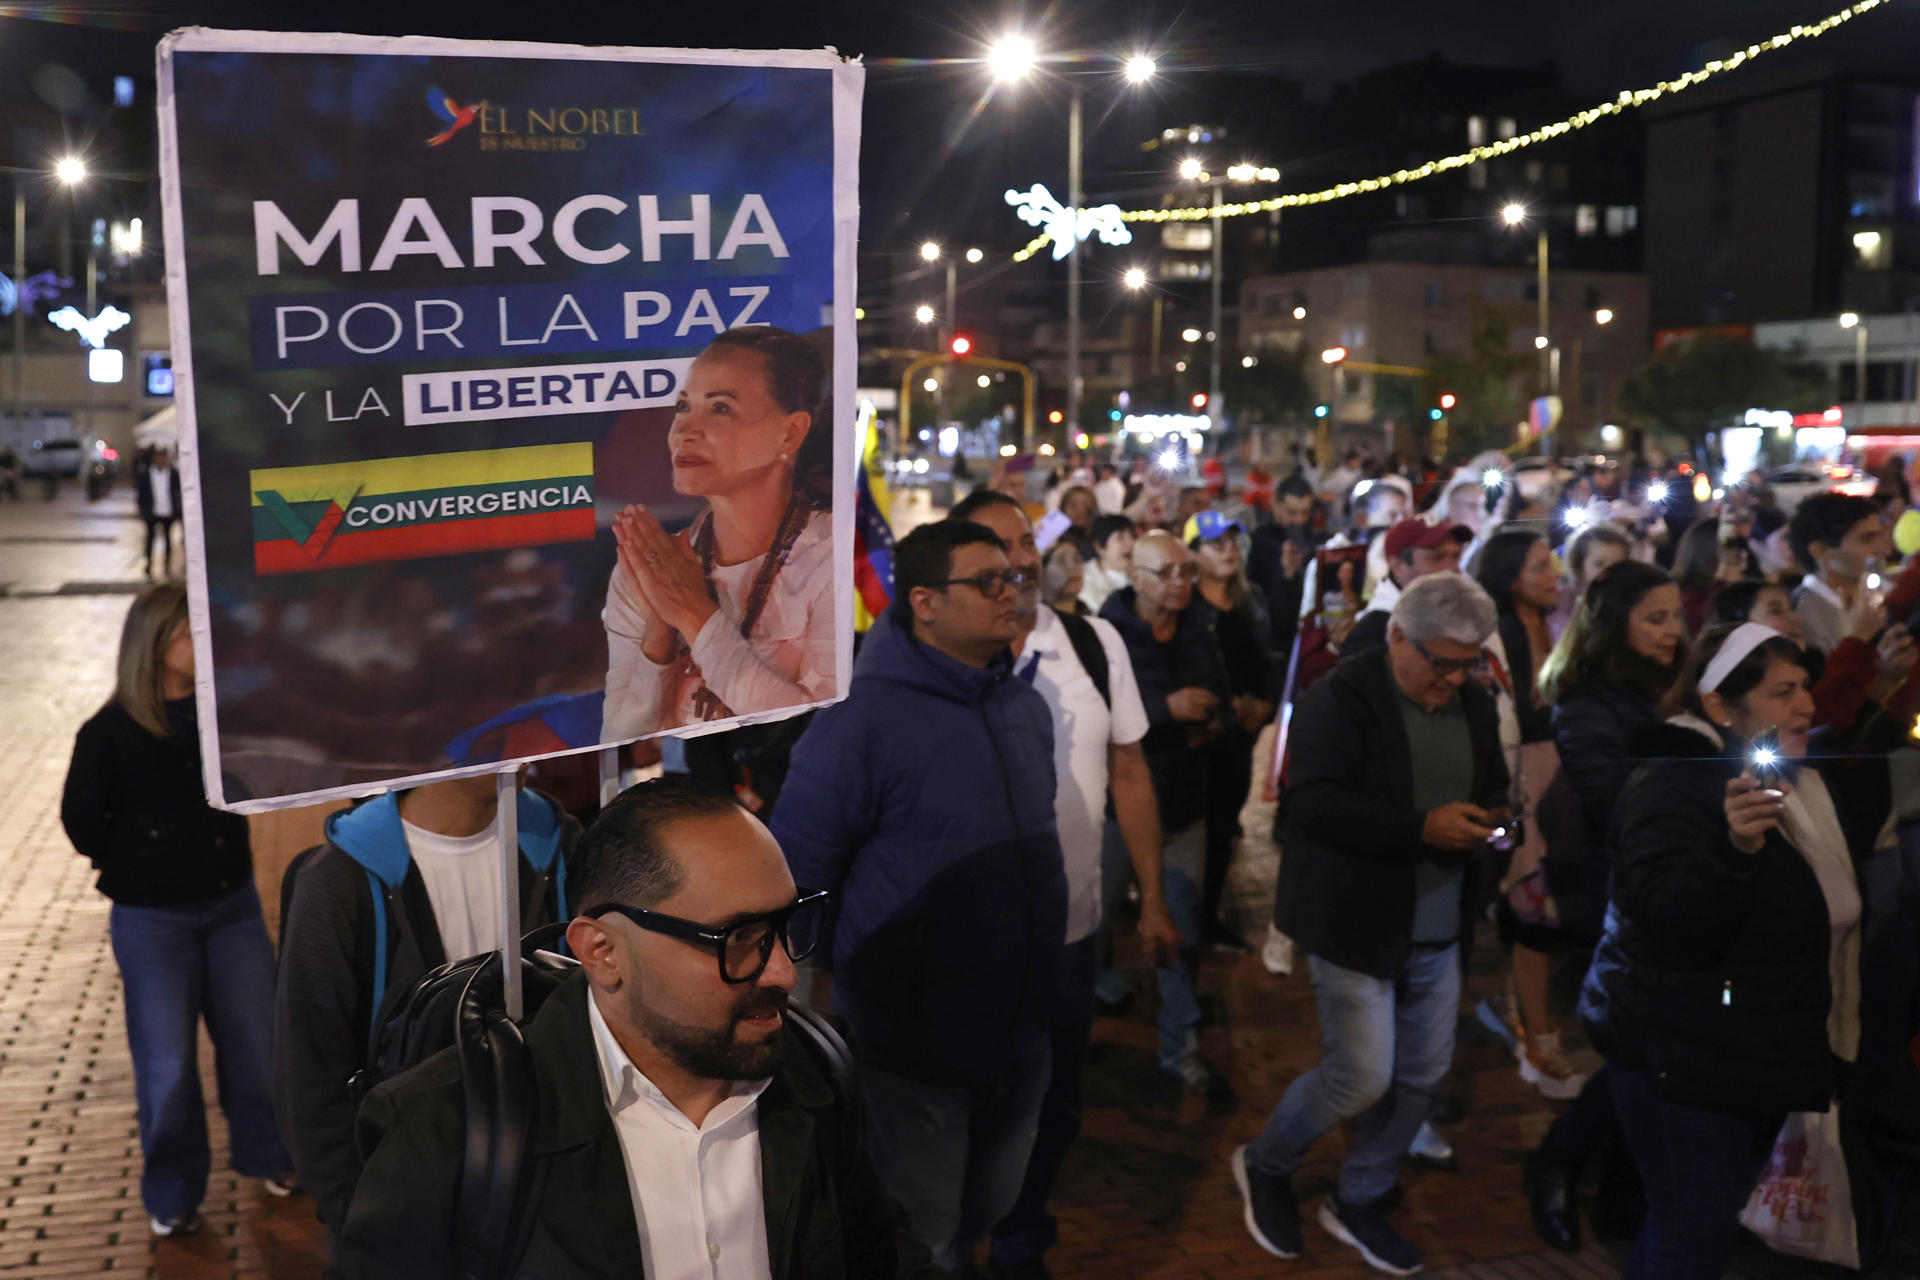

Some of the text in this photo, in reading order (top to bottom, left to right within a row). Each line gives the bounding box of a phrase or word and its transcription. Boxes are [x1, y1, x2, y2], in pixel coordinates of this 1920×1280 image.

[480, 103, 647, 135] EL NOBEL
[503, 137, 587, 151] NUESTRO
[253, 193, 790, 275] MARCHA
[275, 285, 770, 359] POR LA PAZ
[269, 368, 676, 425] Y LA LIBERTAD
[345, 484, 593, 527] CONVERGENCIA
